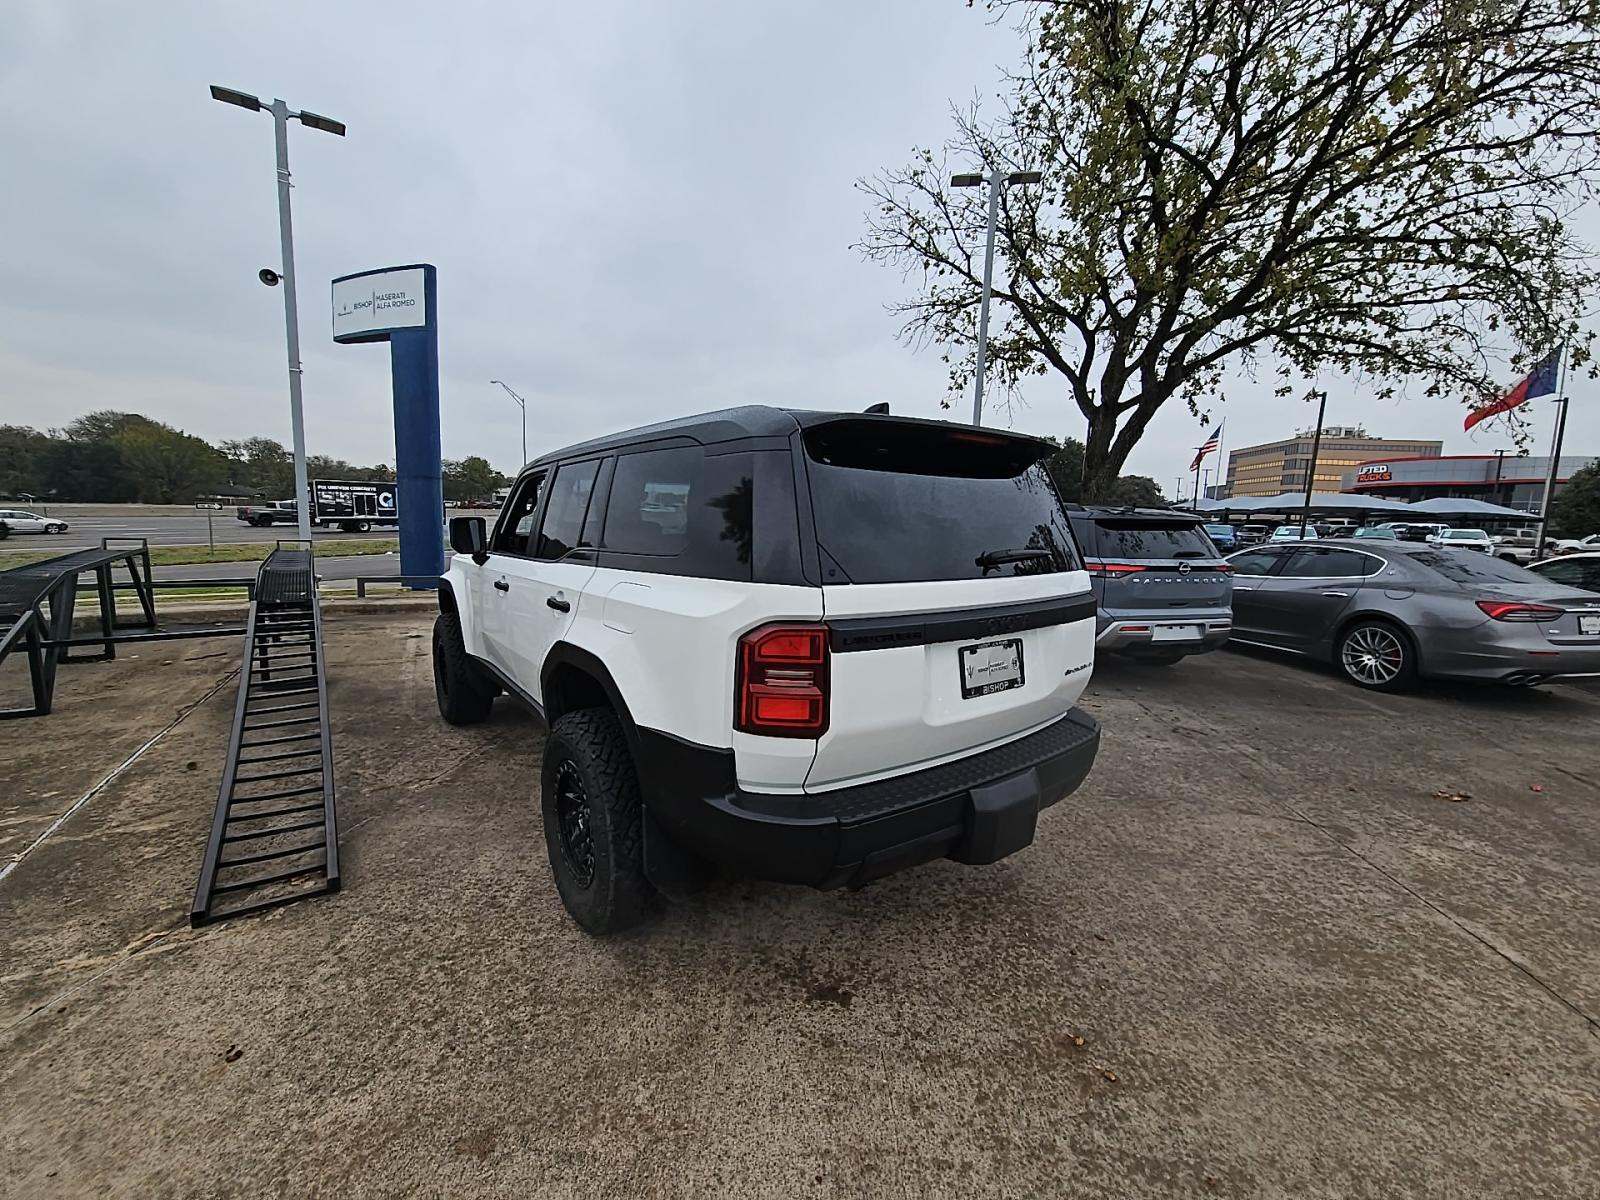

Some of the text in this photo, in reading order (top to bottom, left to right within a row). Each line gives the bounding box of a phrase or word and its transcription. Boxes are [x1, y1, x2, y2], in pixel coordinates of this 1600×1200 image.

[376, 292, 405, 301] MASERATI
[353, 300, 372, 310] BISHOP
[376, 299, 416, 309] ALFA ROMEO
[982, 681, 1009, 694] BISHOP
